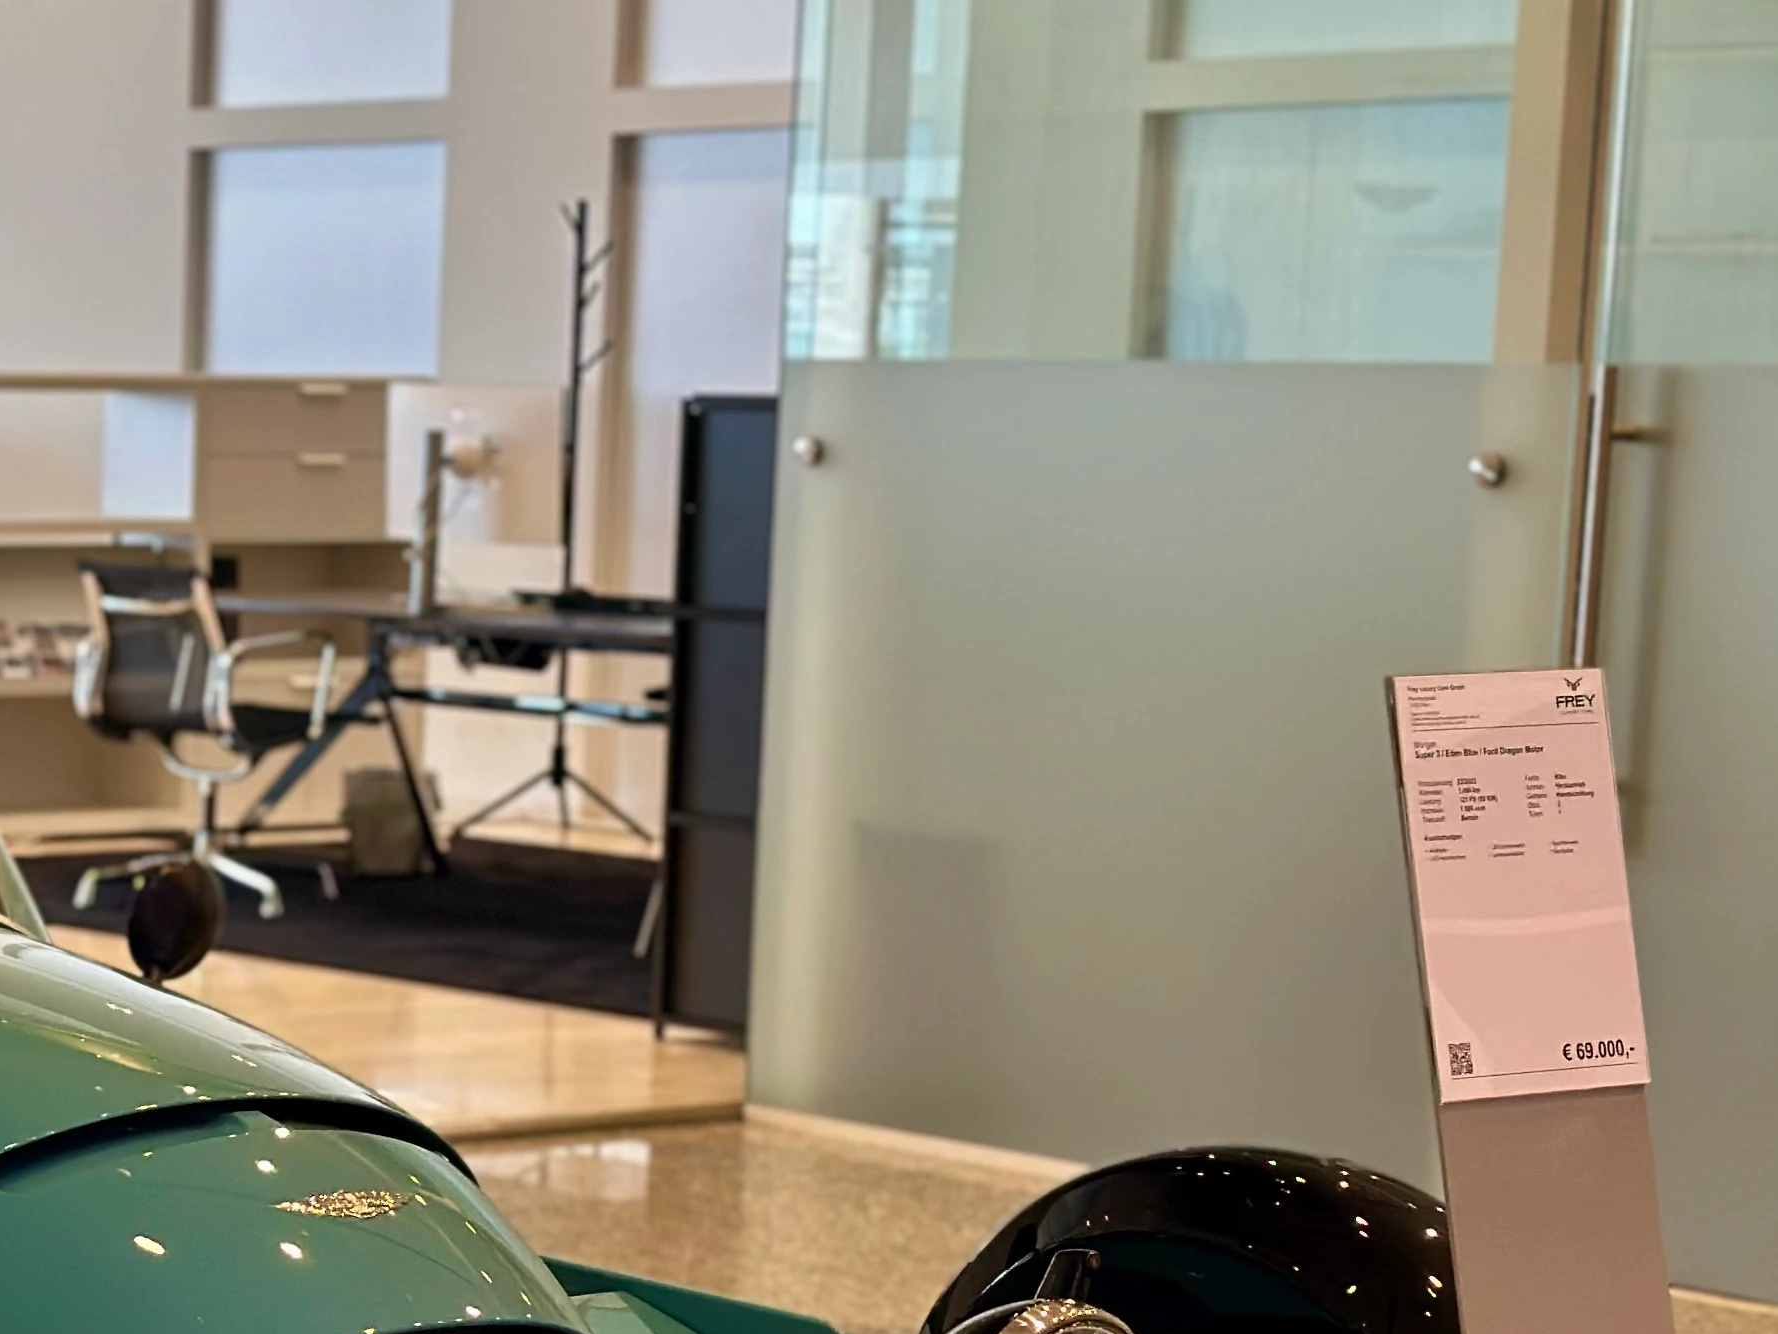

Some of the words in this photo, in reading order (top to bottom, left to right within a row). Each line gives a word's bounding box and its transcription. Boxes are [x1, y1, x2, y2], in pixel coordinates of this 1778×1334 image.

[1555, 694, 1596, 708] FREY
[1562, 1043, 1573, 1061] €
[1576, 1039, 1635, 1060] 69.000,-
